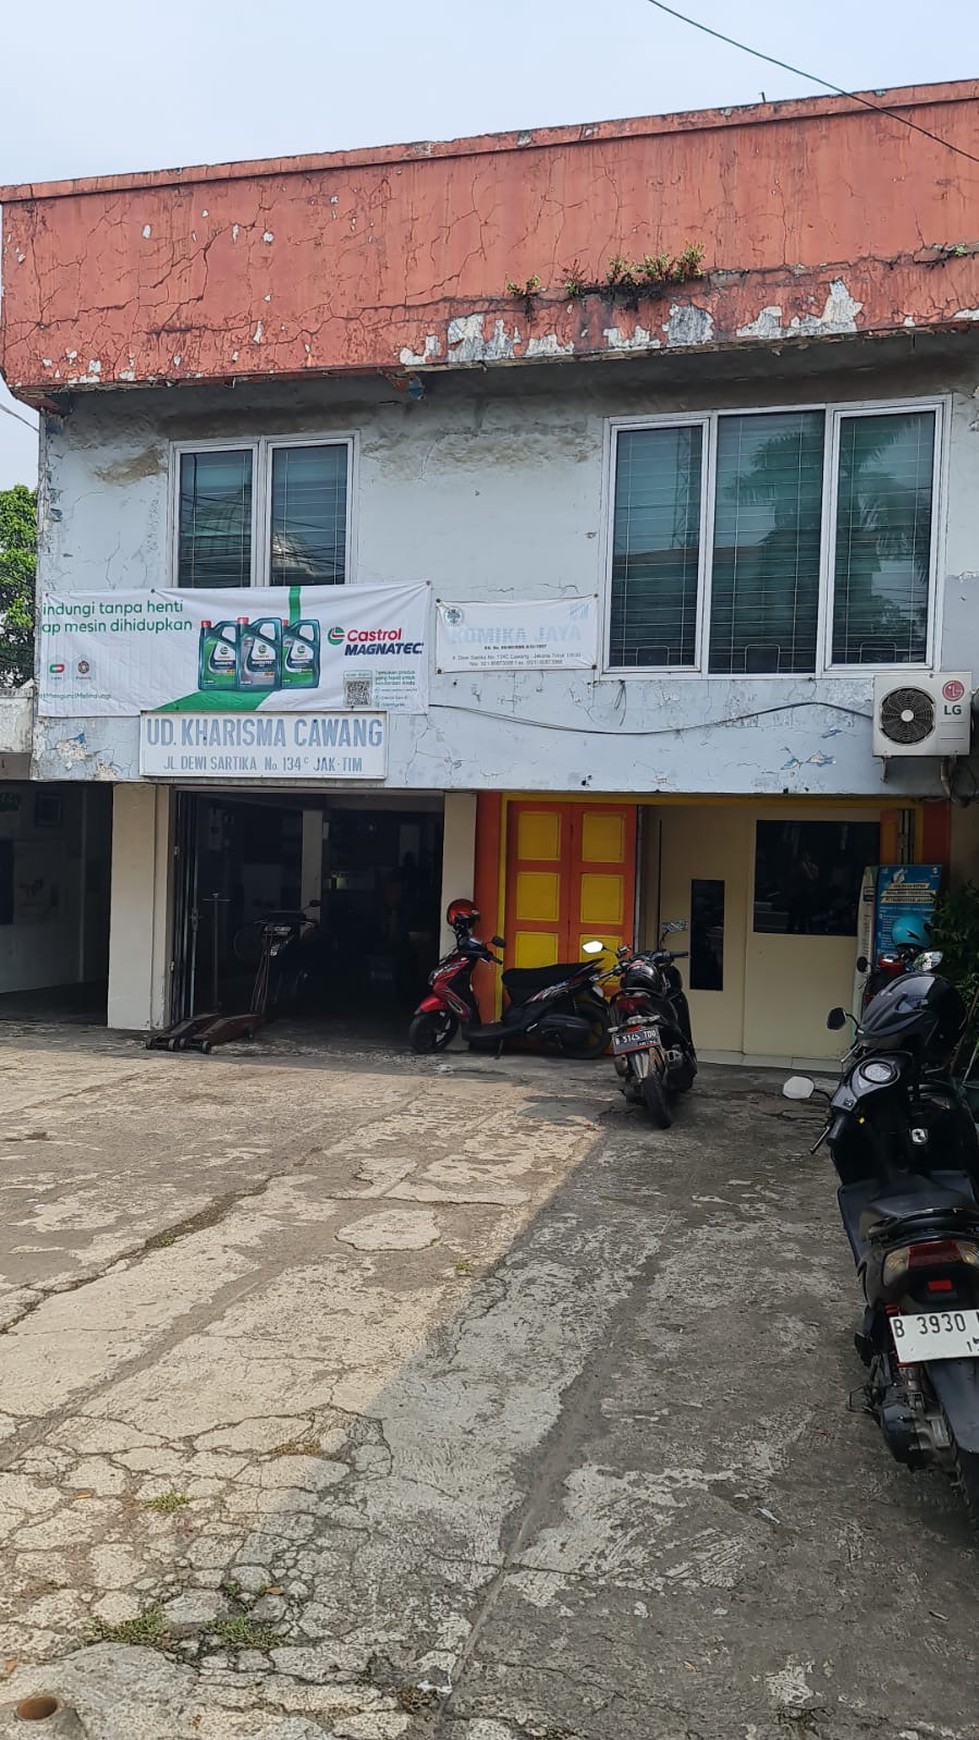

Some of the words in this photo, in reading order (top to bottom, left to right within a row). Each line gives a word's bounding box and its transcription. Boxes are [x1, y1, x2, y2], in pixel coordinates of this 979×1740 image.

[43, 602, 95, 618] indungi
[99, 602, 143, 616] tanpa
[147, 600, 183, 613] henti
[42, 622, 61, 636] ap
[64, 619, 107, 632] mesin
[110, 617, 193, 634] dihidupkan
[347, 627, 402, 642] Castrol
[534, 625, 581, 642] JAYA
[344, 642, 424, 656] MAGNATEC
[944, 705, 962, 715] LG
[147, 718, 177, 746] UD.
[181, 718, 286, 747] KHARISMA
[294, 718, 382, 747] CAWANG
[181, 755, 207, 770] DEWI
[210, 755, 257, 770] SARTIKA
[892, 1318, 904, 1338] B
[916, 1313, 966, 1335] 3930
